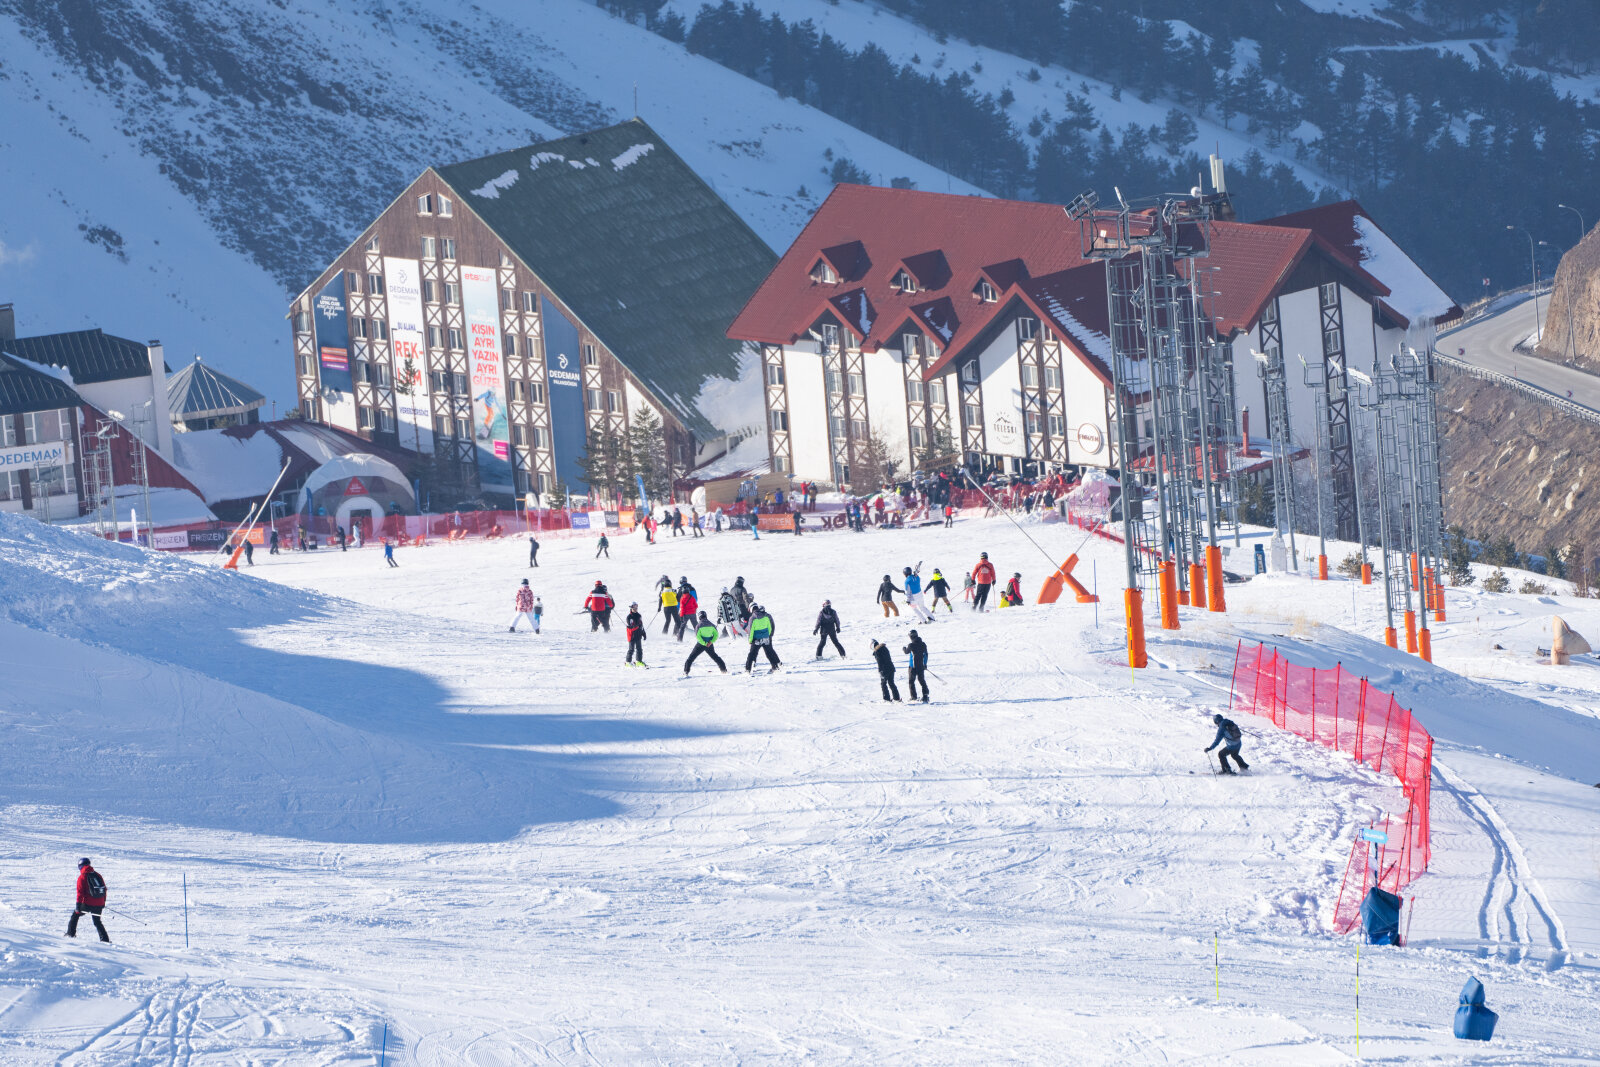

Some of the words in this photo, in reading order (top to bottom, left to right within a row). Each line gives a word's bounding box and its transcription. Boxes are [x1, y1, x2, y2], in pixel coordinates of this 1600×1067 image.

[389, 285, 419, 295] DEDEMAN
[471, 323, 495, 336] KIŞIN
[474, 336, 495, 349] AYRI
[395, 340, 424, 359] REK-
[472, 349, 498, 362] YAZIN
[477, 362, 497, 374] AYRI
[549, 369, 580, 381] DEDEMAN
[0, 447, 62, 466] DEDEMAN
[190, 532, 225, 542] FROZEN
